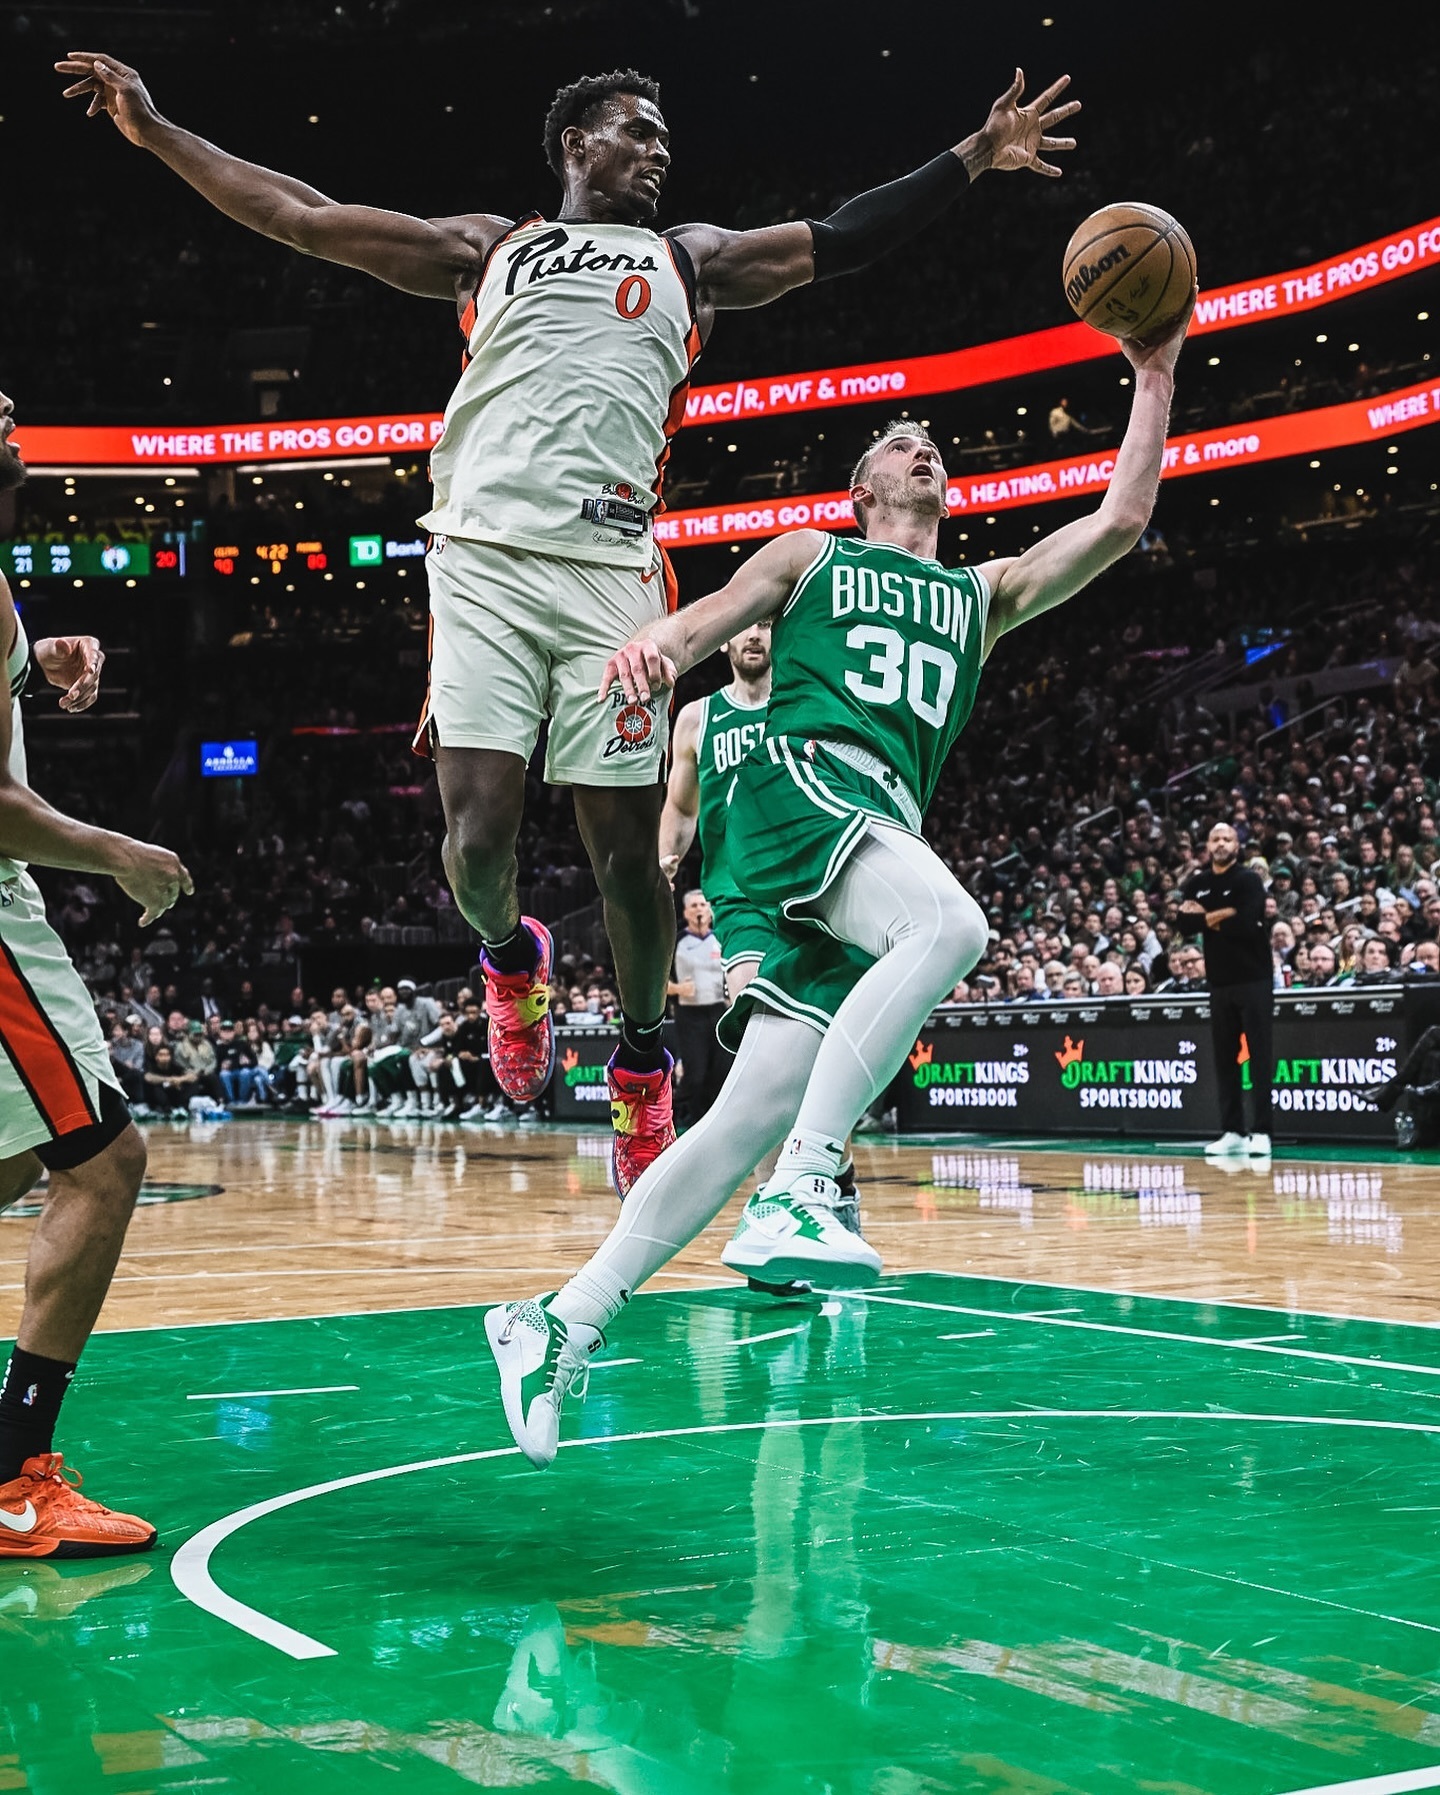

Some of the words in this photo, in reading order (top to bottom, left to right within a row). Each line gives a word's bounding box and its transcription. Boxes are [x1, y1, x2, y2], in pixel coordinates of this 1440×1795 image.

[505, 227, 658, 296] Pistons
[1066, 244, 1131, 307] Wilson
[1195, 285, 1278, 324] WHERE
[1282, 271, 1324, 304] THE
[1326, 252, 1380, 292] PROS
[1381, 238, 1415, 271] GO
[1417, 226, 1440, 259] FO
[615, 275, 652, 320] 0
[686, 382, 765, 418] VAC/R,
[771, 380, 812, 406] PVF
[817, 378, 835, 399] &
[841, 372, 906, 396] more
[1367, 392, 1429, 429] WHERE
[131, 433, 216, 456] WHERE
[221, 431, 264, 453] THE
[268, 427, 332, 451] PROS
[335, 424, 374, 447] GO
[378, 422, 425, 445] FOR
[683, 515, 719, 537] THE
[722, 509, 774, 532] PROS
[778, 502, 810, 525] GO
[813, 499, 853, 523] FOR
[970, 472, 1056, 503] HEATING,
[1060, 460, 1114, 488] HVAC
[1184, 443, 1200, 465] &
[1204, 434, 1260, 462] more
[15, 557, 33, 574] 21
[51, 557, 72, 574] 29
[353, 540, 379, 561] TD
[385, 539, 426, 558] Bank
[832, 565, 973, 655] BOSTON
[844, 624, 959, 730] 30
[603, 733, 656, 758] Detroit
[713, 722, 765, 774] BOST
[1013, 1044, 1029, 1057] 21+
[1178, 1041, 1197, 1055] 21+
[1375, 1036, 1397, 1053] 21+
[913, 1061, 1030, 1089] DRAFTKINGS
[1061, 1060, 1198, 1089] DRAFTKINGS
[1272, 1058, 1398, 1084] AFTKINGS
[929, 1088, 1017, 1107] SPORTSBOOK
[1080, 1088, 1183, 1109] SPORTSBOOK
